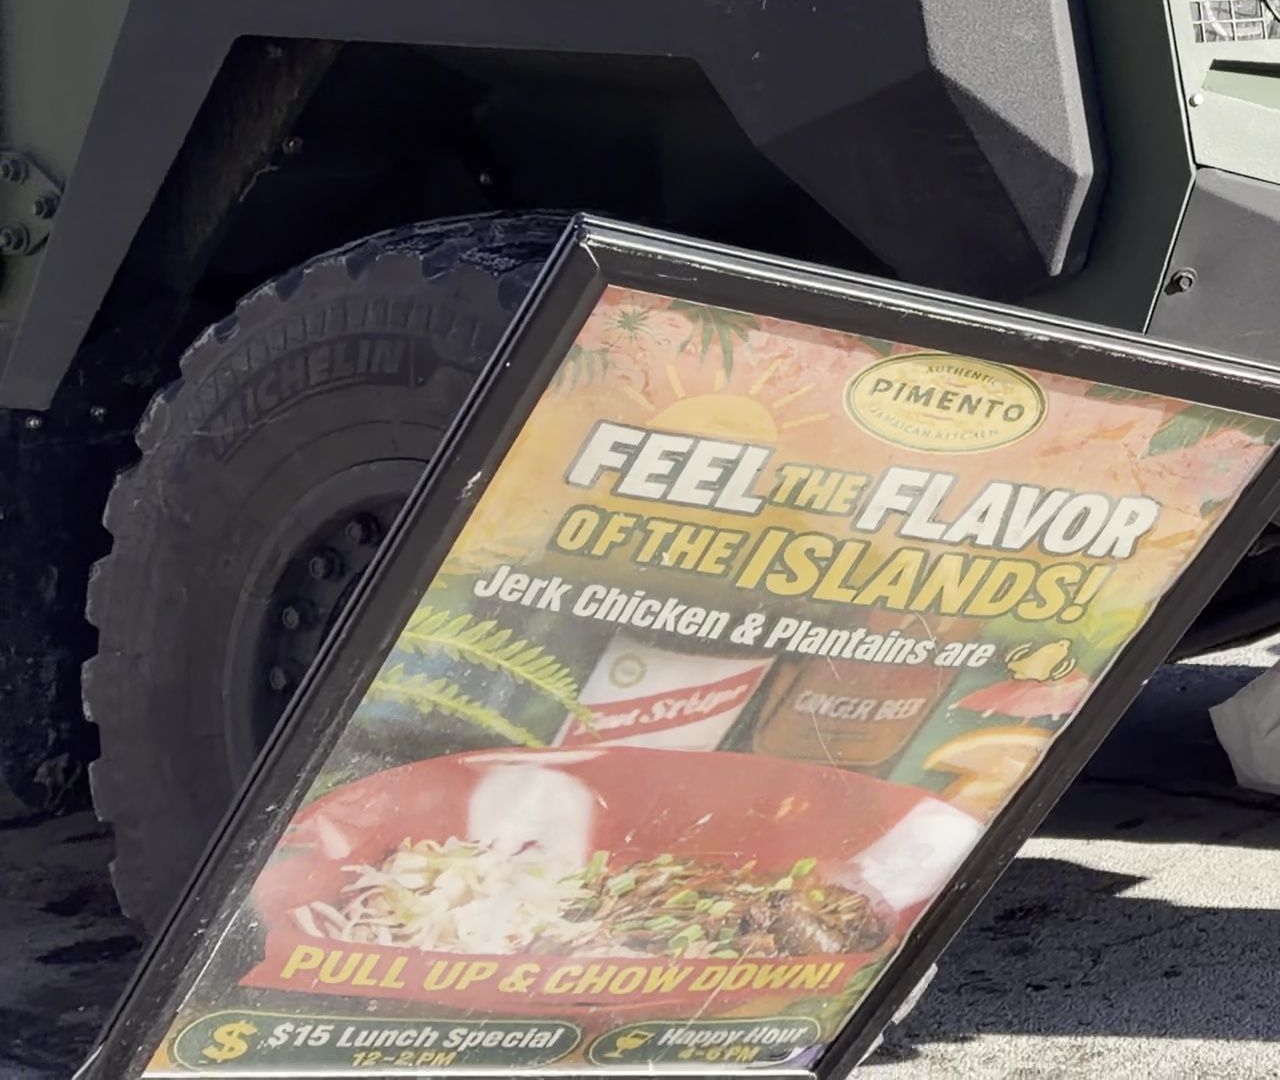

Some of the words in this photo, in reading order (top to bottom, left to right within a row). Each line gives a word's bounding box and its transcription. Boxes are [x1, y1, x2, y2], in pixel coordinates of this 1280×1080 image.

[219, 338, 404, 442] MICHELIN
[869, 378, 1026, 423] PIMENTO
[567, 422, 774, 514] FEEL
[773, 466, 868, 515] THE
[857, 467, 1161, 558] FLAVOR
[556, 507, 637, 556] OF
[636, 520, 747, 576] THE
[736, 529, 1112, 622] ISLANDS!
[474, 565, 572, 613] Jerk
[572, 584, 732, 641] Chicken
[730, 613, 764, 646] &
[764, 617, 937, 667] Plantains
[934, 641, 996, 668] are
[794, 690, 876, 721] GINGER
[280, 945, 409, 988] PULL
[423, 960, 499, 991] UP
[498, 963, 541, 993] &
[544, 963, 694, 995] CHOW
[688, 962, 845, 992] DOWN!
[268, 1022, 335, 1047] $15
[336, 1026, 442, 1048] Lunch
[443, 1027, 565, 1052] Special
[414, 1052, 458, 1067] PM
[658, 1028, 745, 1048] Happy
[743, 1026, 809, 1045] Hour
[722, 1046, 761, 1063] PM
